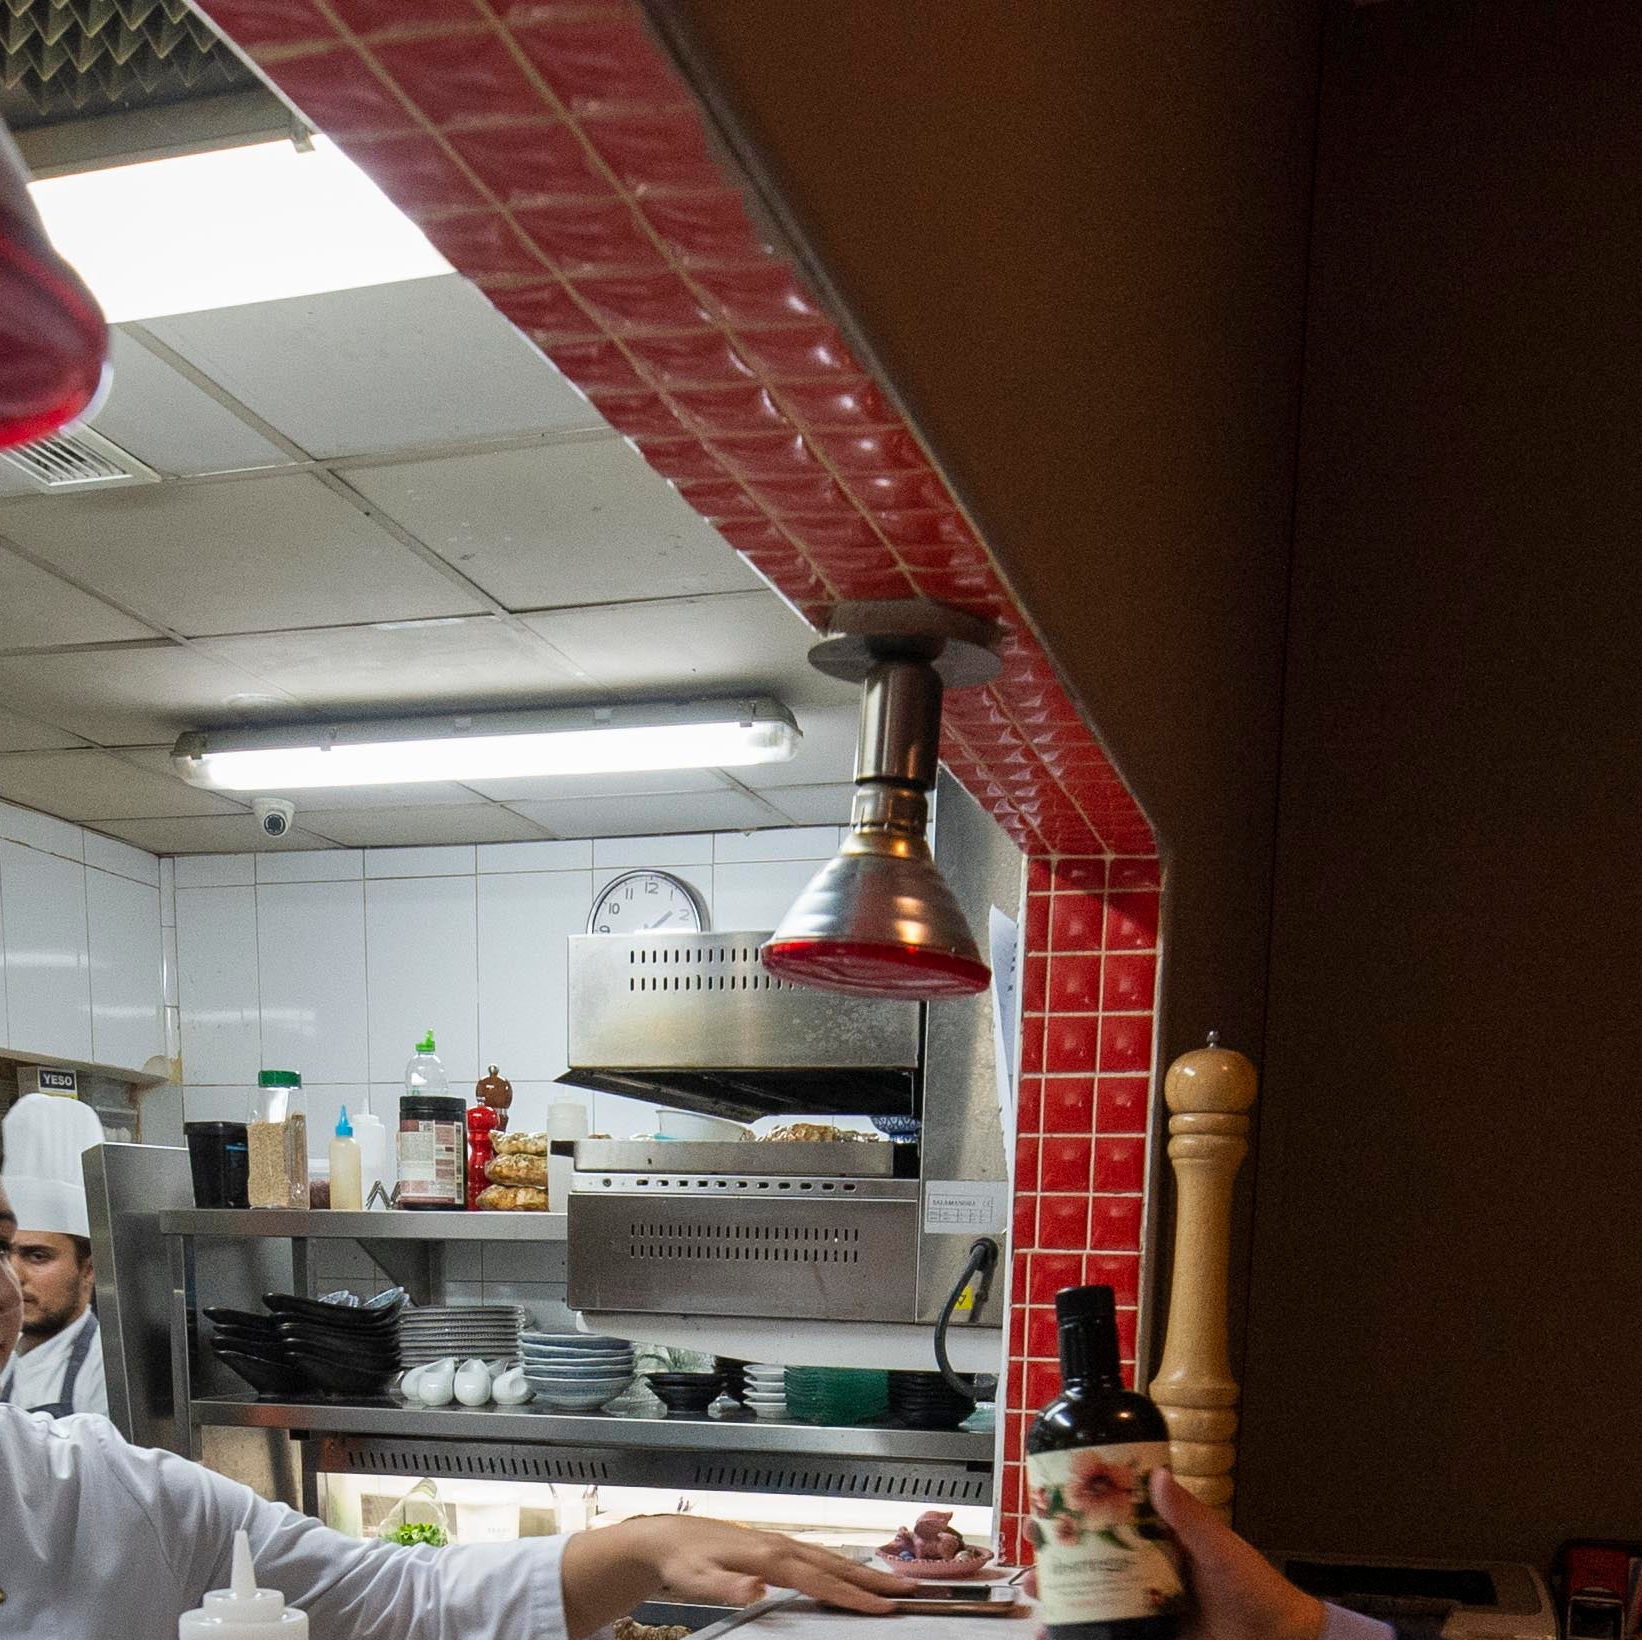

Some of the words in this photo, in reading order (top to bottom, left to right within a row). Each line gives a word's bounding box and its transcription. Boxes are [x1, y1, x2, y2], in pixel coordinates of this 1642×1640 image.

[625, 887, 634, 900] 11
[644, 881, 659, 894] 12
[608, 902, 621, 915] 10
[678, 908, 690, 921] 2
[42, 1073, 73, 1087] YESO
